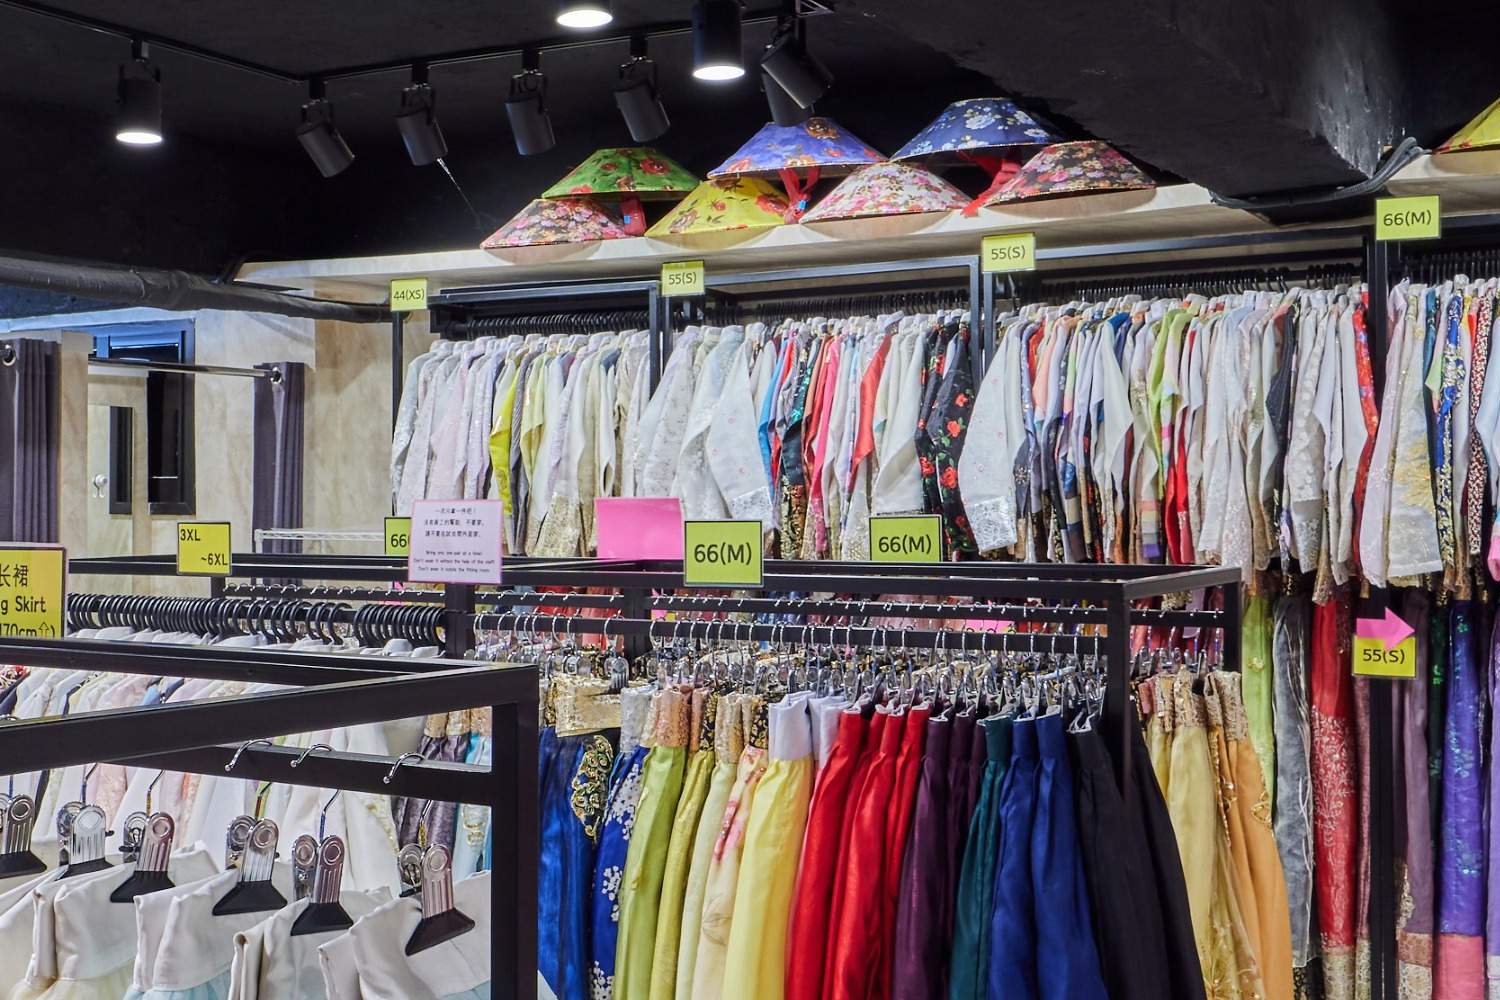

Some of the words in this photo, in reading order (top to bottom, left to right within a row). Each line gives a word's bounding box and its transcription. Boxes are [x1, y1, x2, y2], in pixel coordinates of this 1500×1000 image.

[1383, 209, 1432, 227] 66(M)
[991, 245, 1026, 260] 55(S)
[668, 272, 697, 285] 55(S)
[393, 288, 425, 300] 44(XS)
[180, 529, 201, 541] 3XL
[878, 534, 932, 555] 66(M)
[201, 553, 228, 566] ~6XL
[694, 543, 753, 565] 66(M)
[15, 595, 46, 613] Skirt
[1362, 649, 1405, 664] 55(S)
